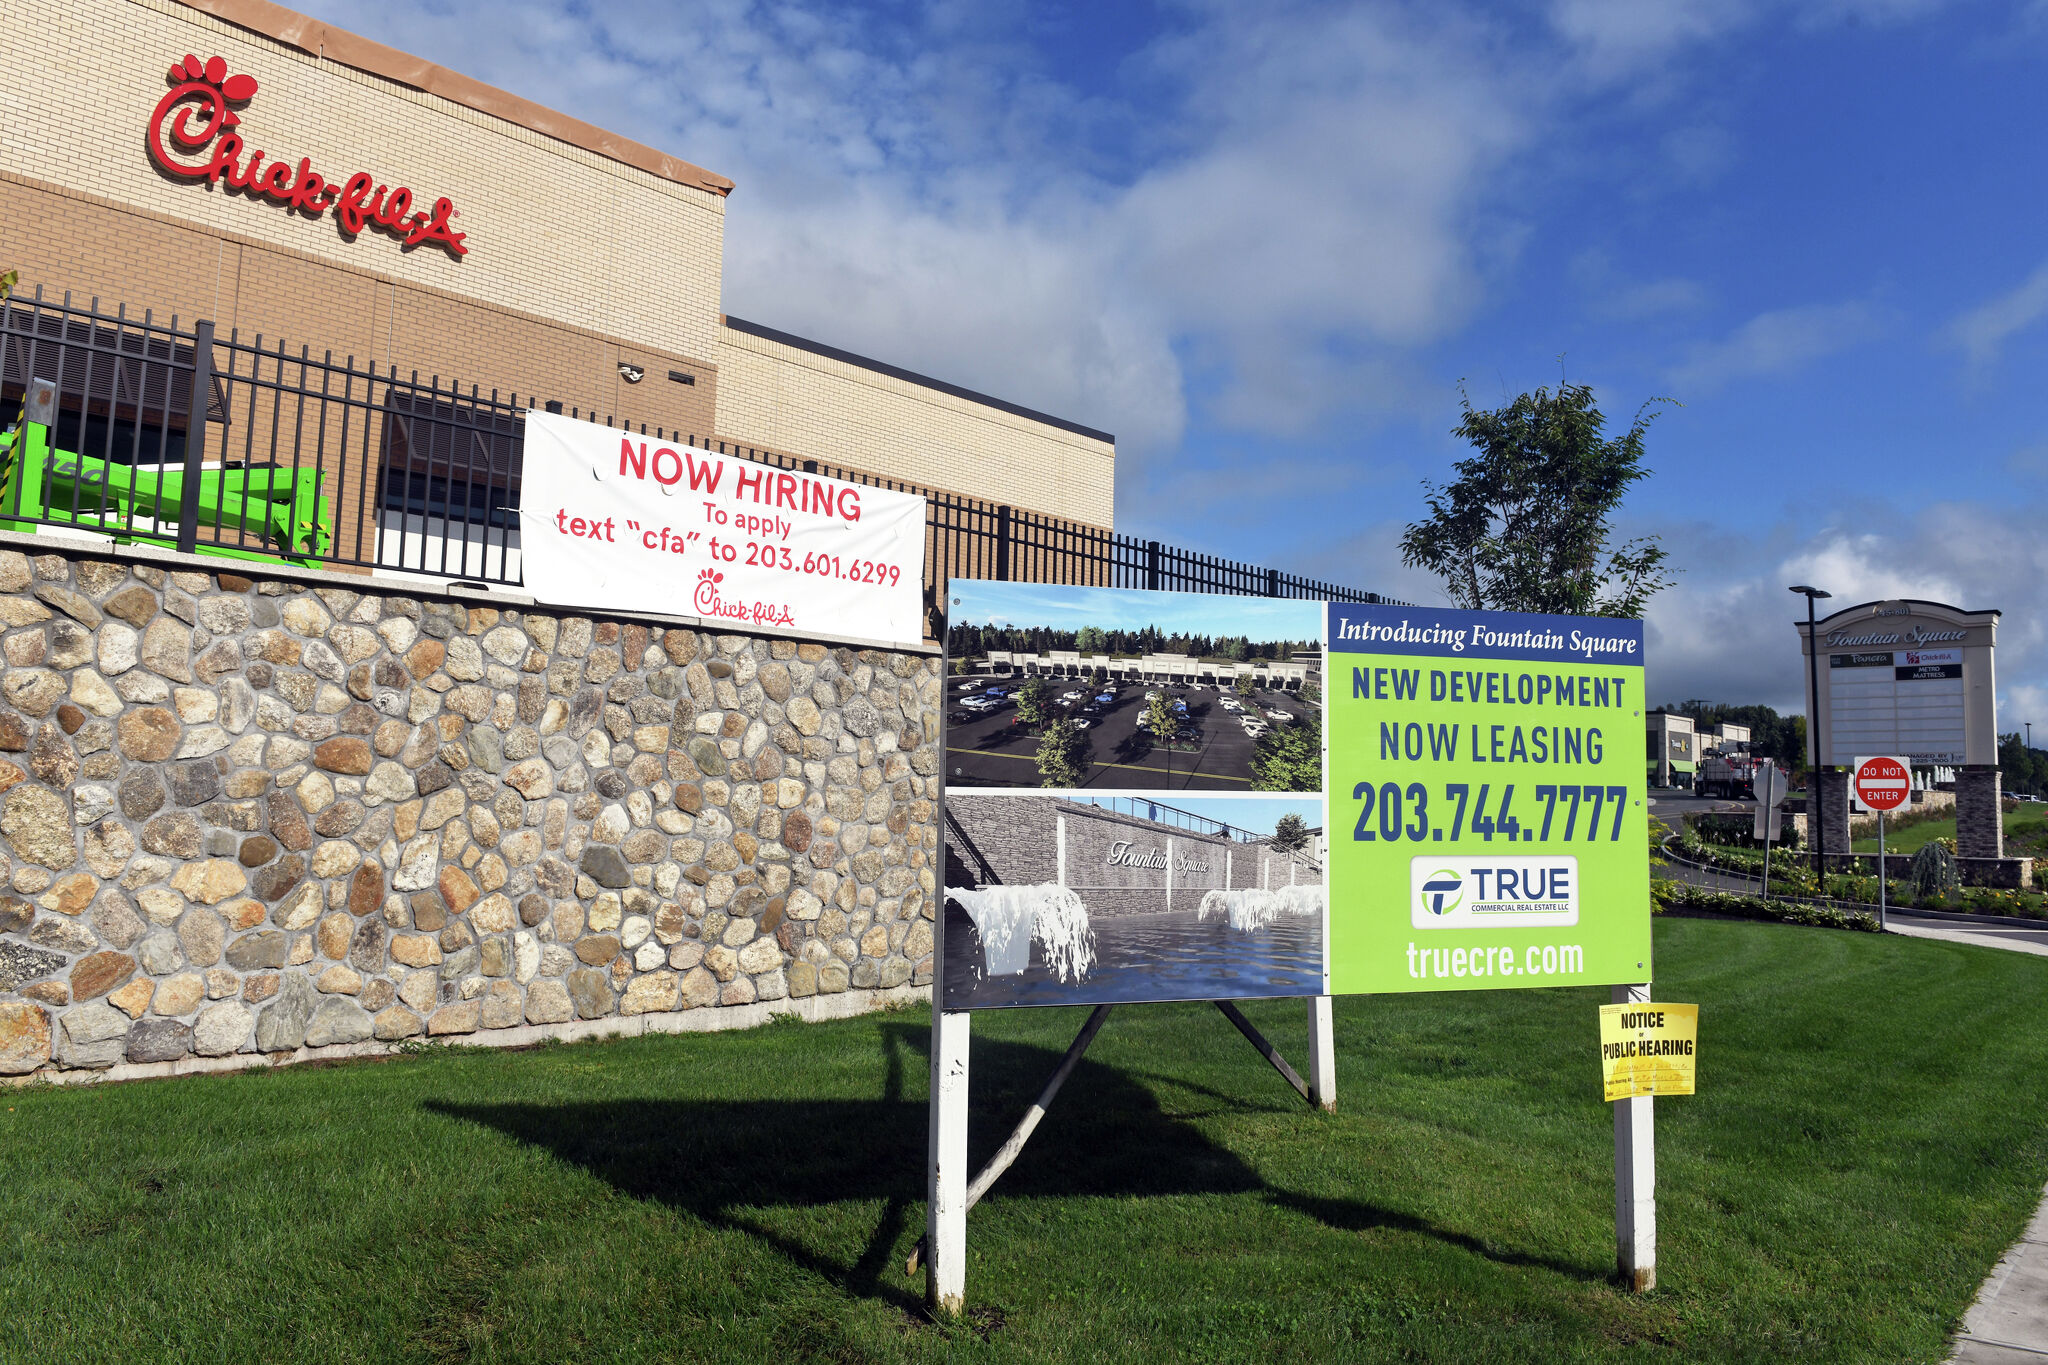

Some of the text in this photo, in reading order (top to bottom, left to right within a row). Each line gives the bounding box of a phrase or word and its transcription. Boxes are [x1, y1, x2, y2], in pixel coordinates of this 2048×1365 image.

[150, 82, 468, 255] Chick-fil-A
[619, 438, 861, 522] NOW HIRING
[703, 502, 792, 541] To apply
[556, 508, 615, 543] text
[709, 536, 736, 562] to
[745, 542, 901, 588] 203.601.6299
[694, 579, 795, 627] Chick-fil-A
[1337, 617, 1637, 658] Introducing Fountain Square
[1824, 624, 1967, 648] Fountain Square
[1352, 666, 1626, 708] NEW DEVELOPMENT
[1380, 721, 1603, 765] NOW LEASING
[1863, 767, 1902, 776] DO NOT
[1352, 781, 1628, 842] 203.744.7777
[1867, 791, 1899, 800] ENTER
[1106, 840, 1211, 877] Fountain Square
[1470, 868, 1569, 900] TRUE
[1471, 904, 1516, 912] COMMERCIAL
[1534, 903, 1556, 911] ESTATE
[1406, 941, 1584, 978] truecre.com
[1621, 1012, 1665, 1029] NOTICE
[1604, 1040, 1693, 1060] PUBLIC HEARING
